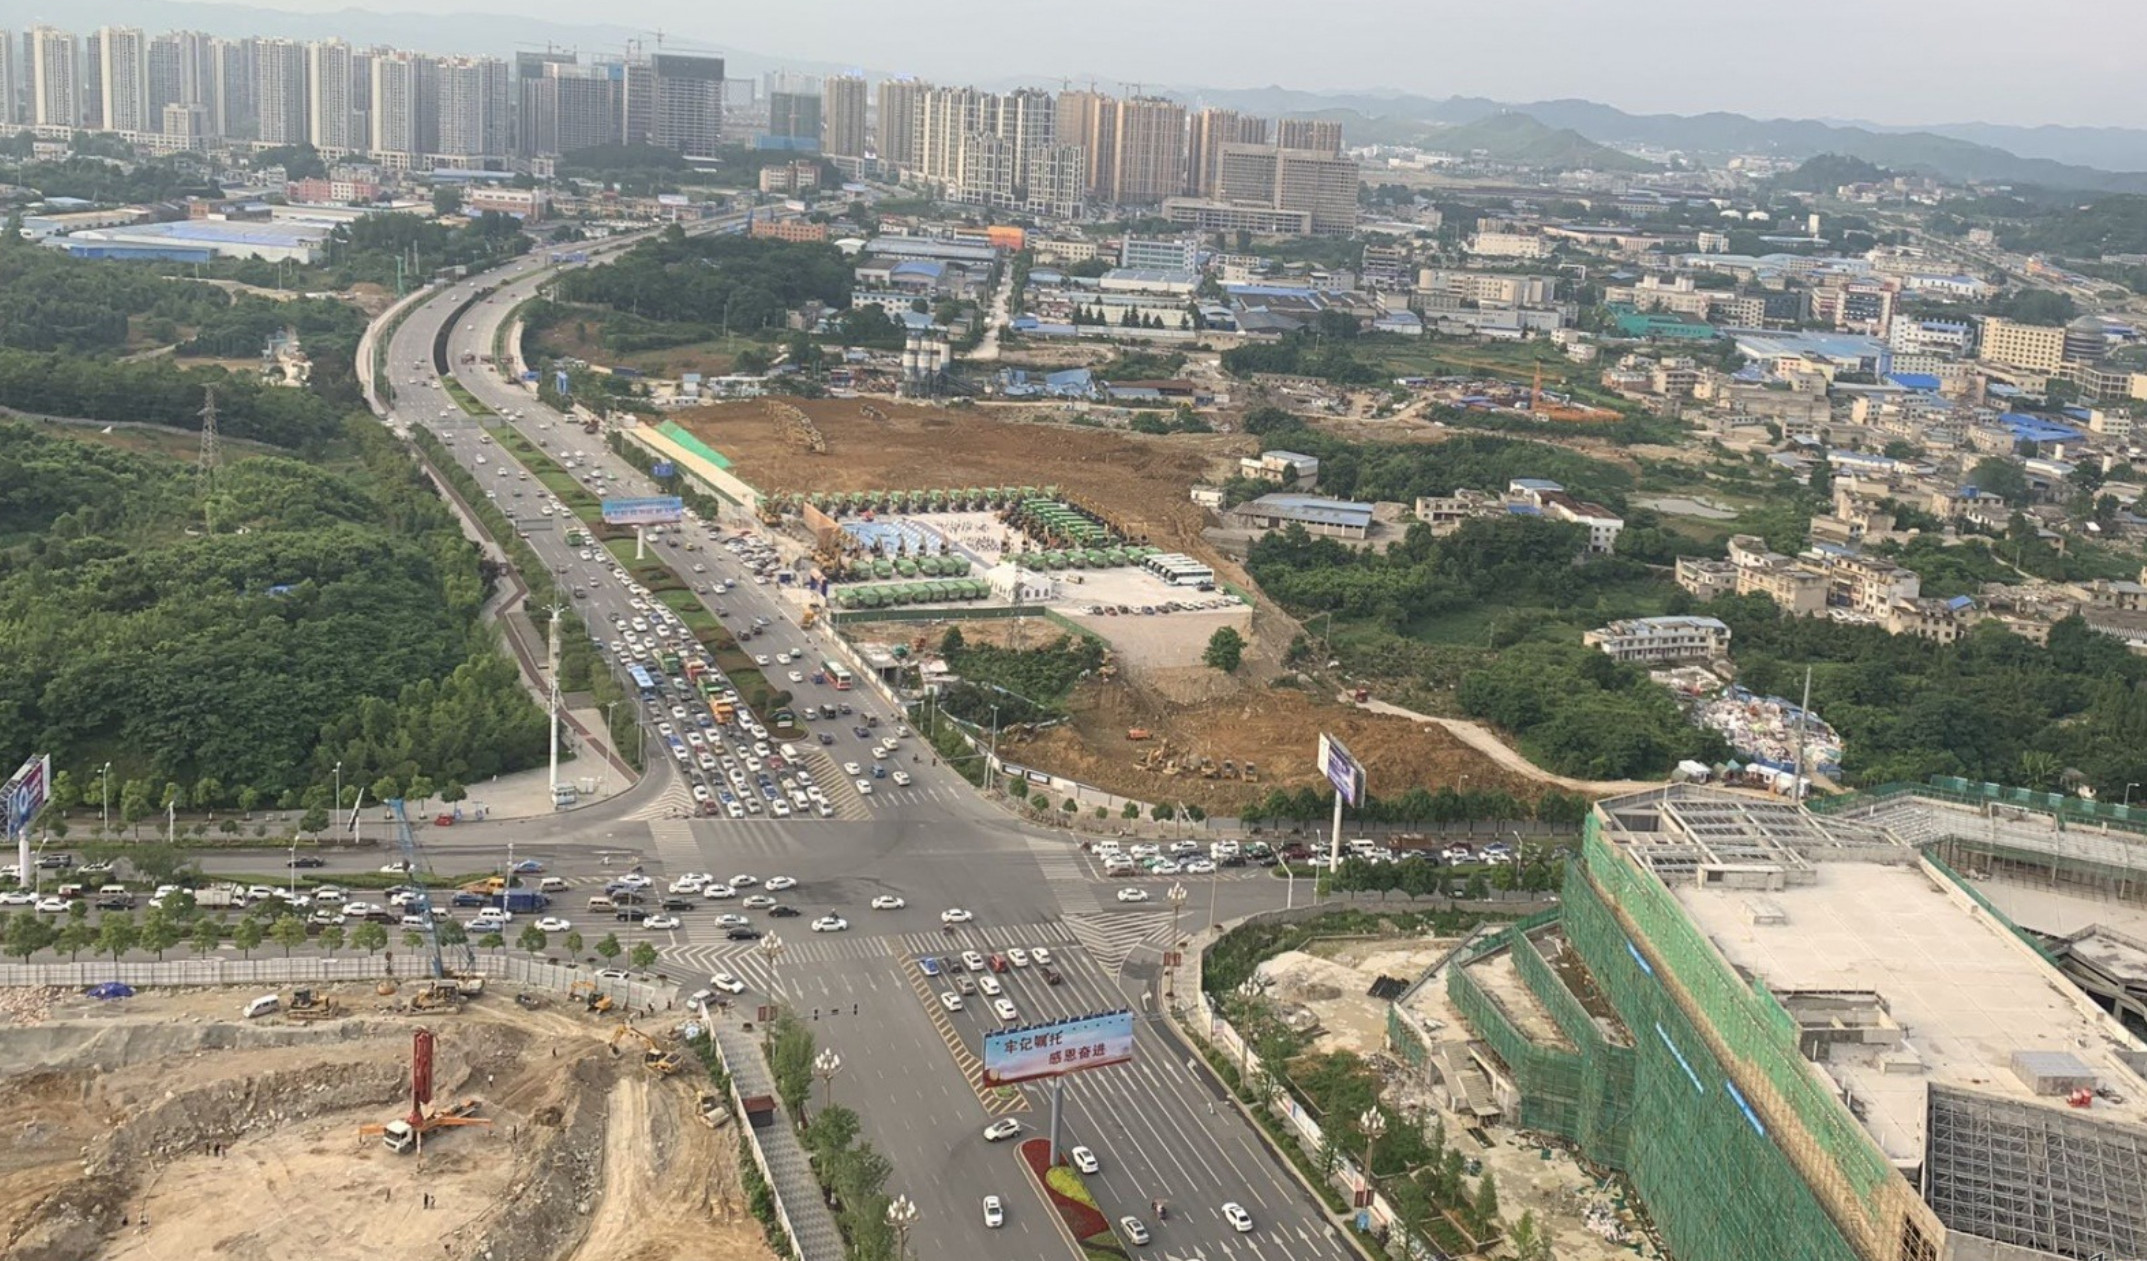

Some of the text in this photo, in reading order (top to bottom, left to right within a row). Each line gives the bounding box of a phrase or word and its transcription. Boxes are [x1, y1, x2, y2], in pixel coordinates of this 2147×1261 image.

[1004, 1030, 1063, 1054] 牢记嘱托
[1048, 1043, 1106, 1065] 感恩奋进
